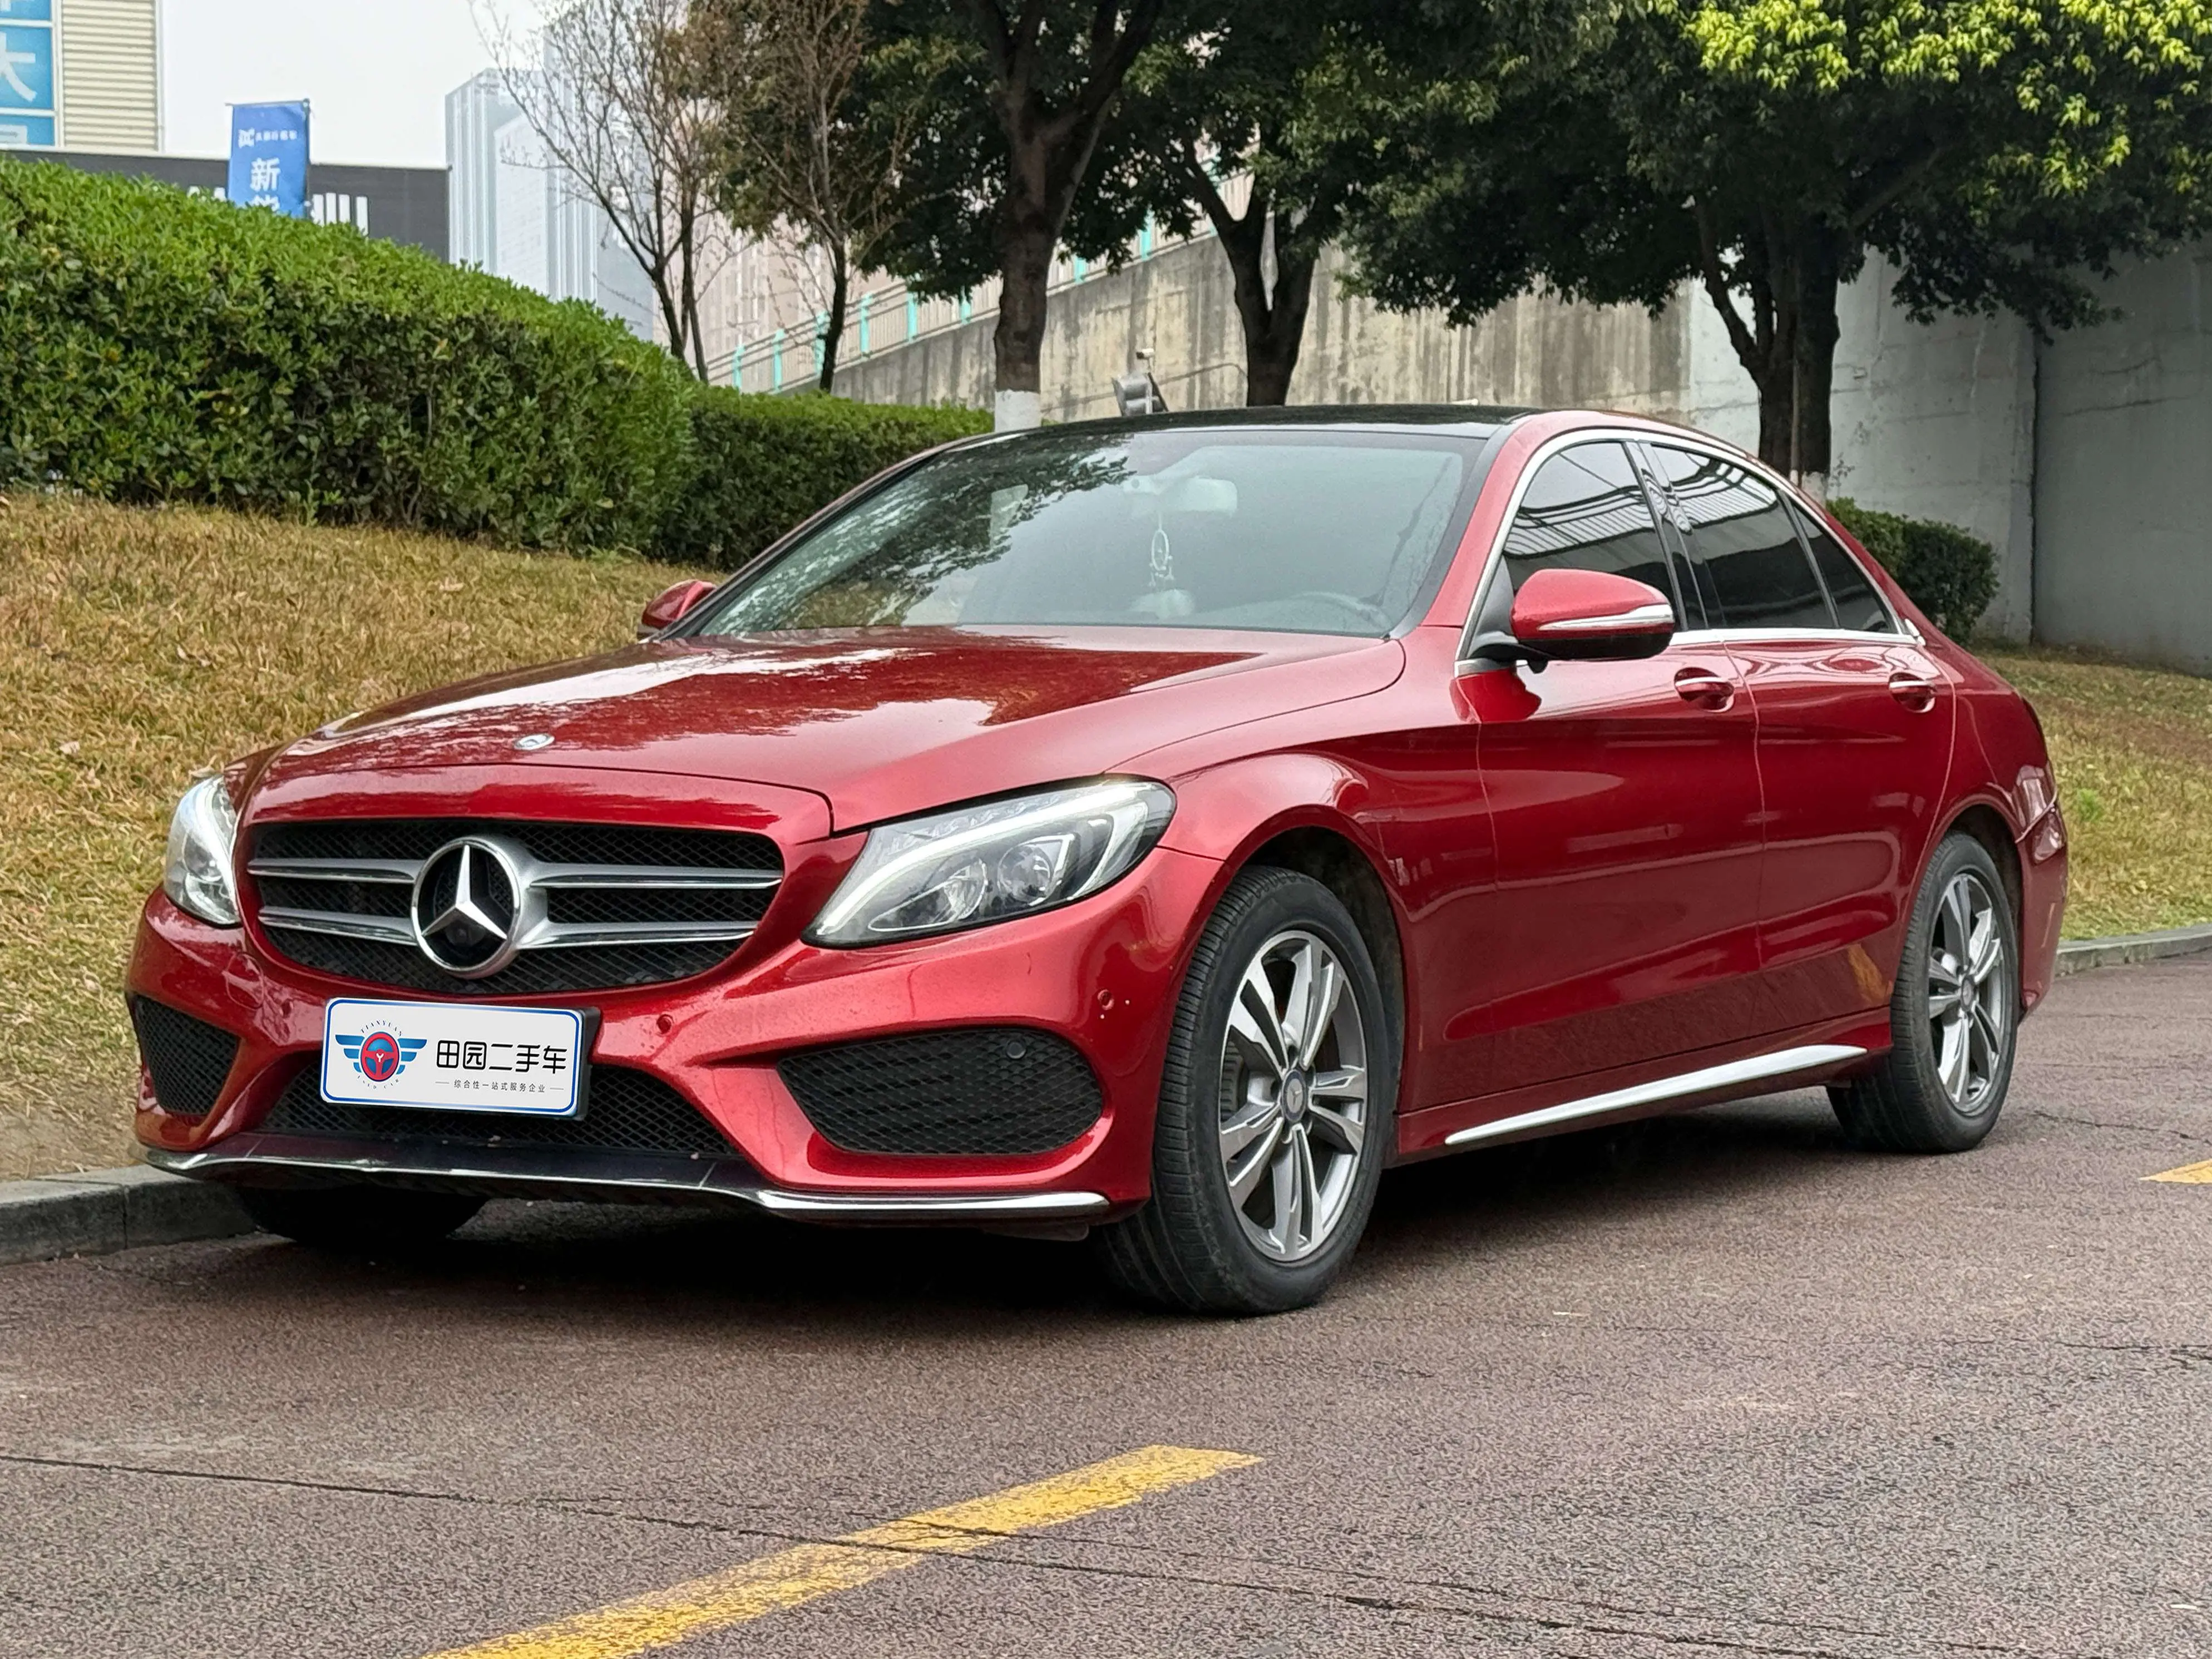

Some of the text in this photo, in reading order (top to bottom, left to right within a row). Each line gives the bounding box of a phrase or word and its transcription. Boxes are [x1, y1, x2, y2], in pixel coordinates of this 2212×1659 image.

[436, 1040, 567, 1074] 田园二手车
[453, 1079, 545, 1093] 综合性一站式服务企业
